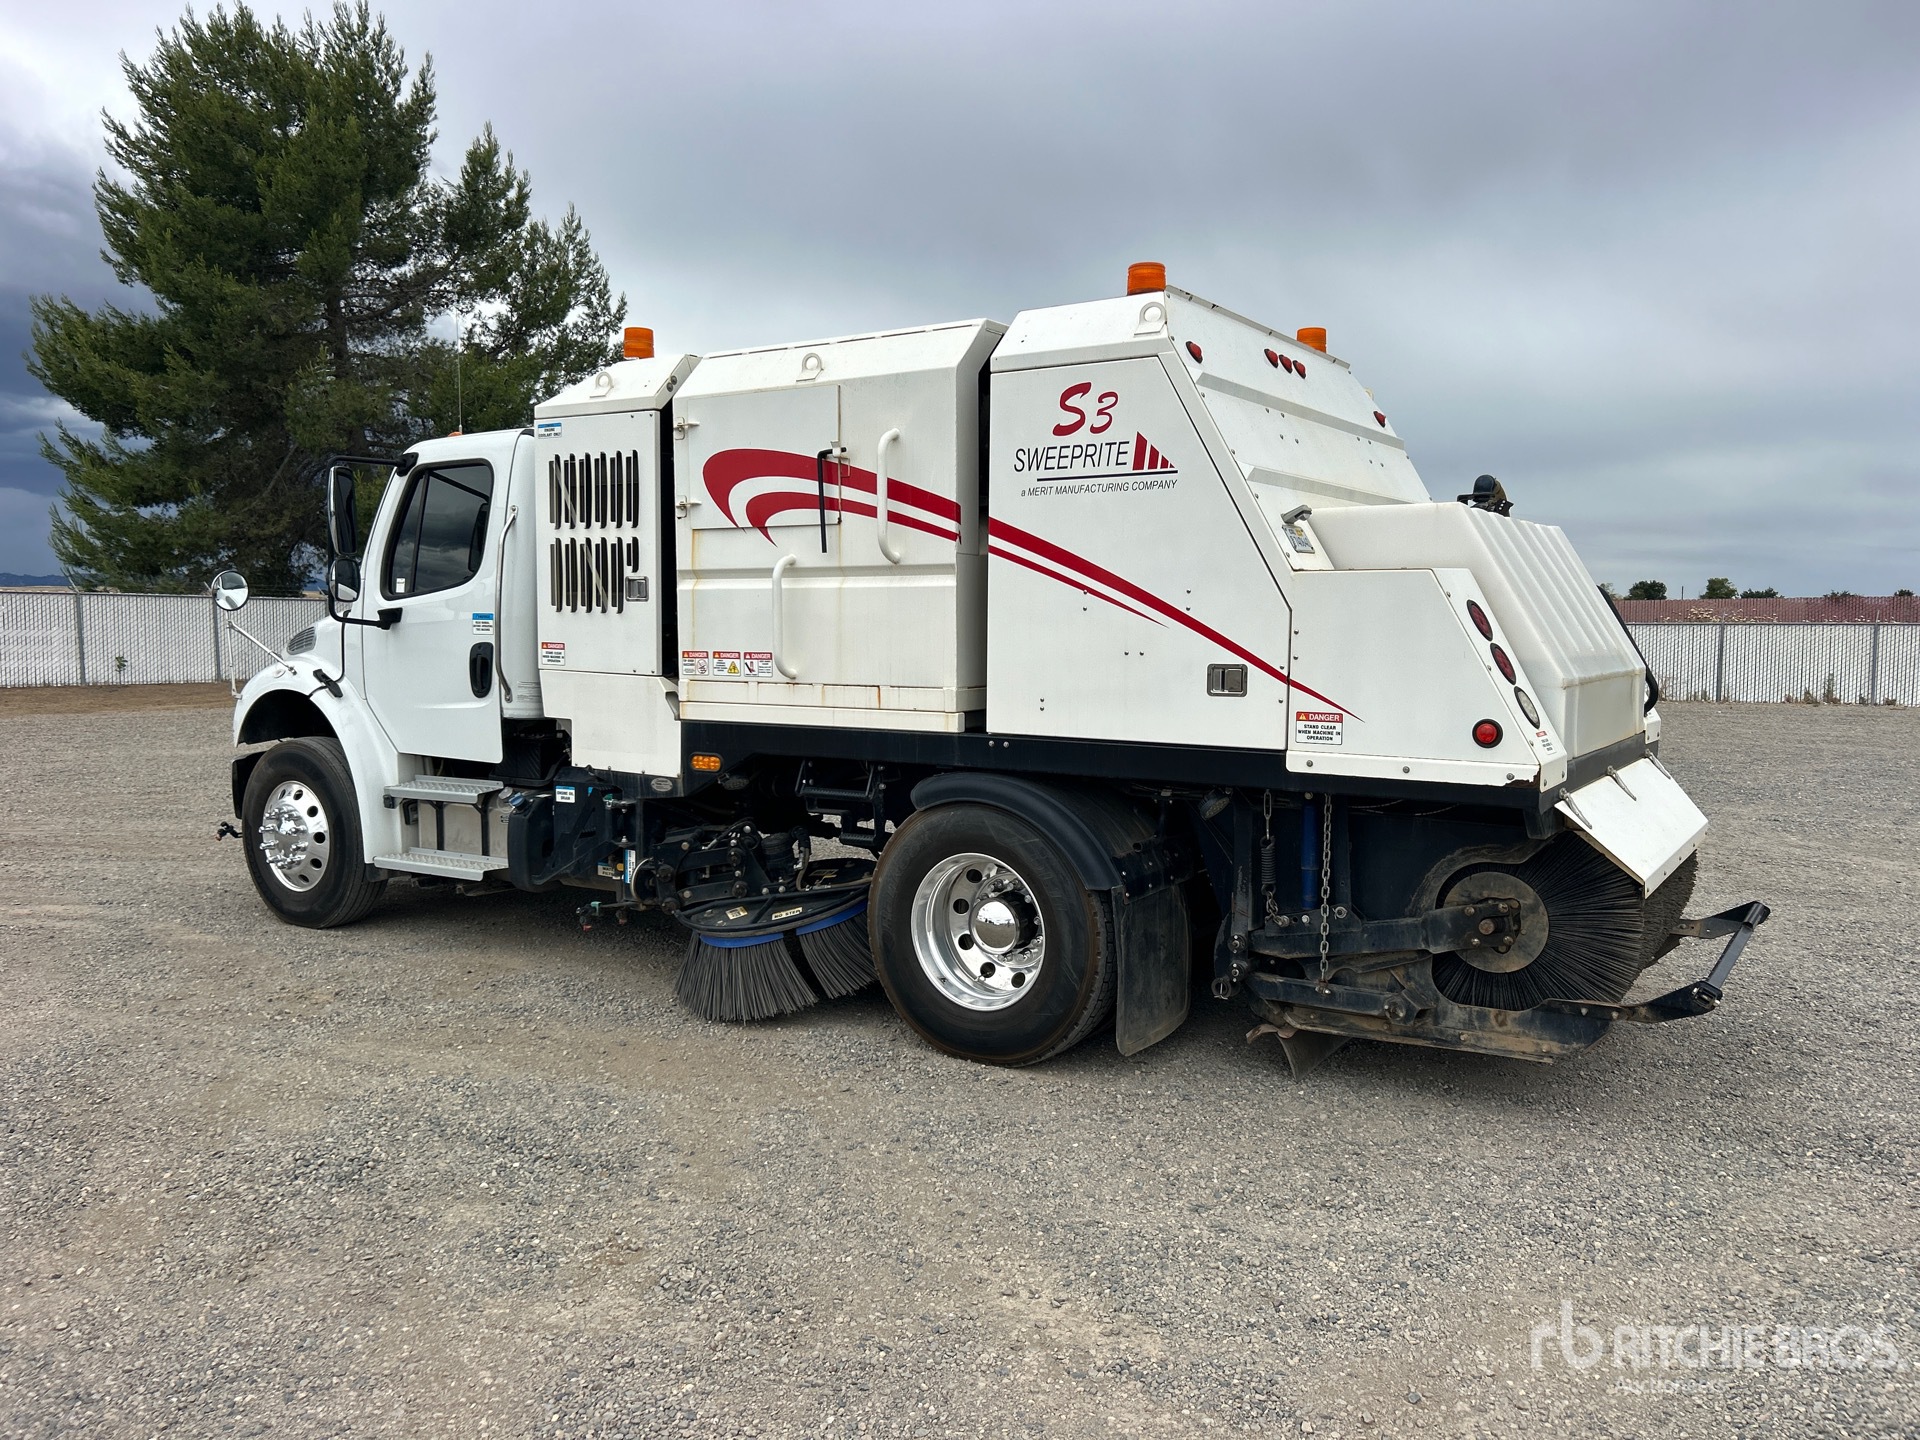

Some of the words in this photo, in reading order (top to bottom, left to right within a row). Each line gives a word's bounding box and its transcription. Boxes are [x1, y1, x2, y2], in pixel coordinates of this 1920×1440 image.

[1052, 382, 1119, 436] S3
[1014, 441, 1130, 472] SWEEPRITE
[1021, 489, 1026, 497] a
[1027, 486, 1054, 497] MERIT
[1055, 482, 1129, 496] MANUFACTURING
[1131, 479, 1178, 492] COMPANY
